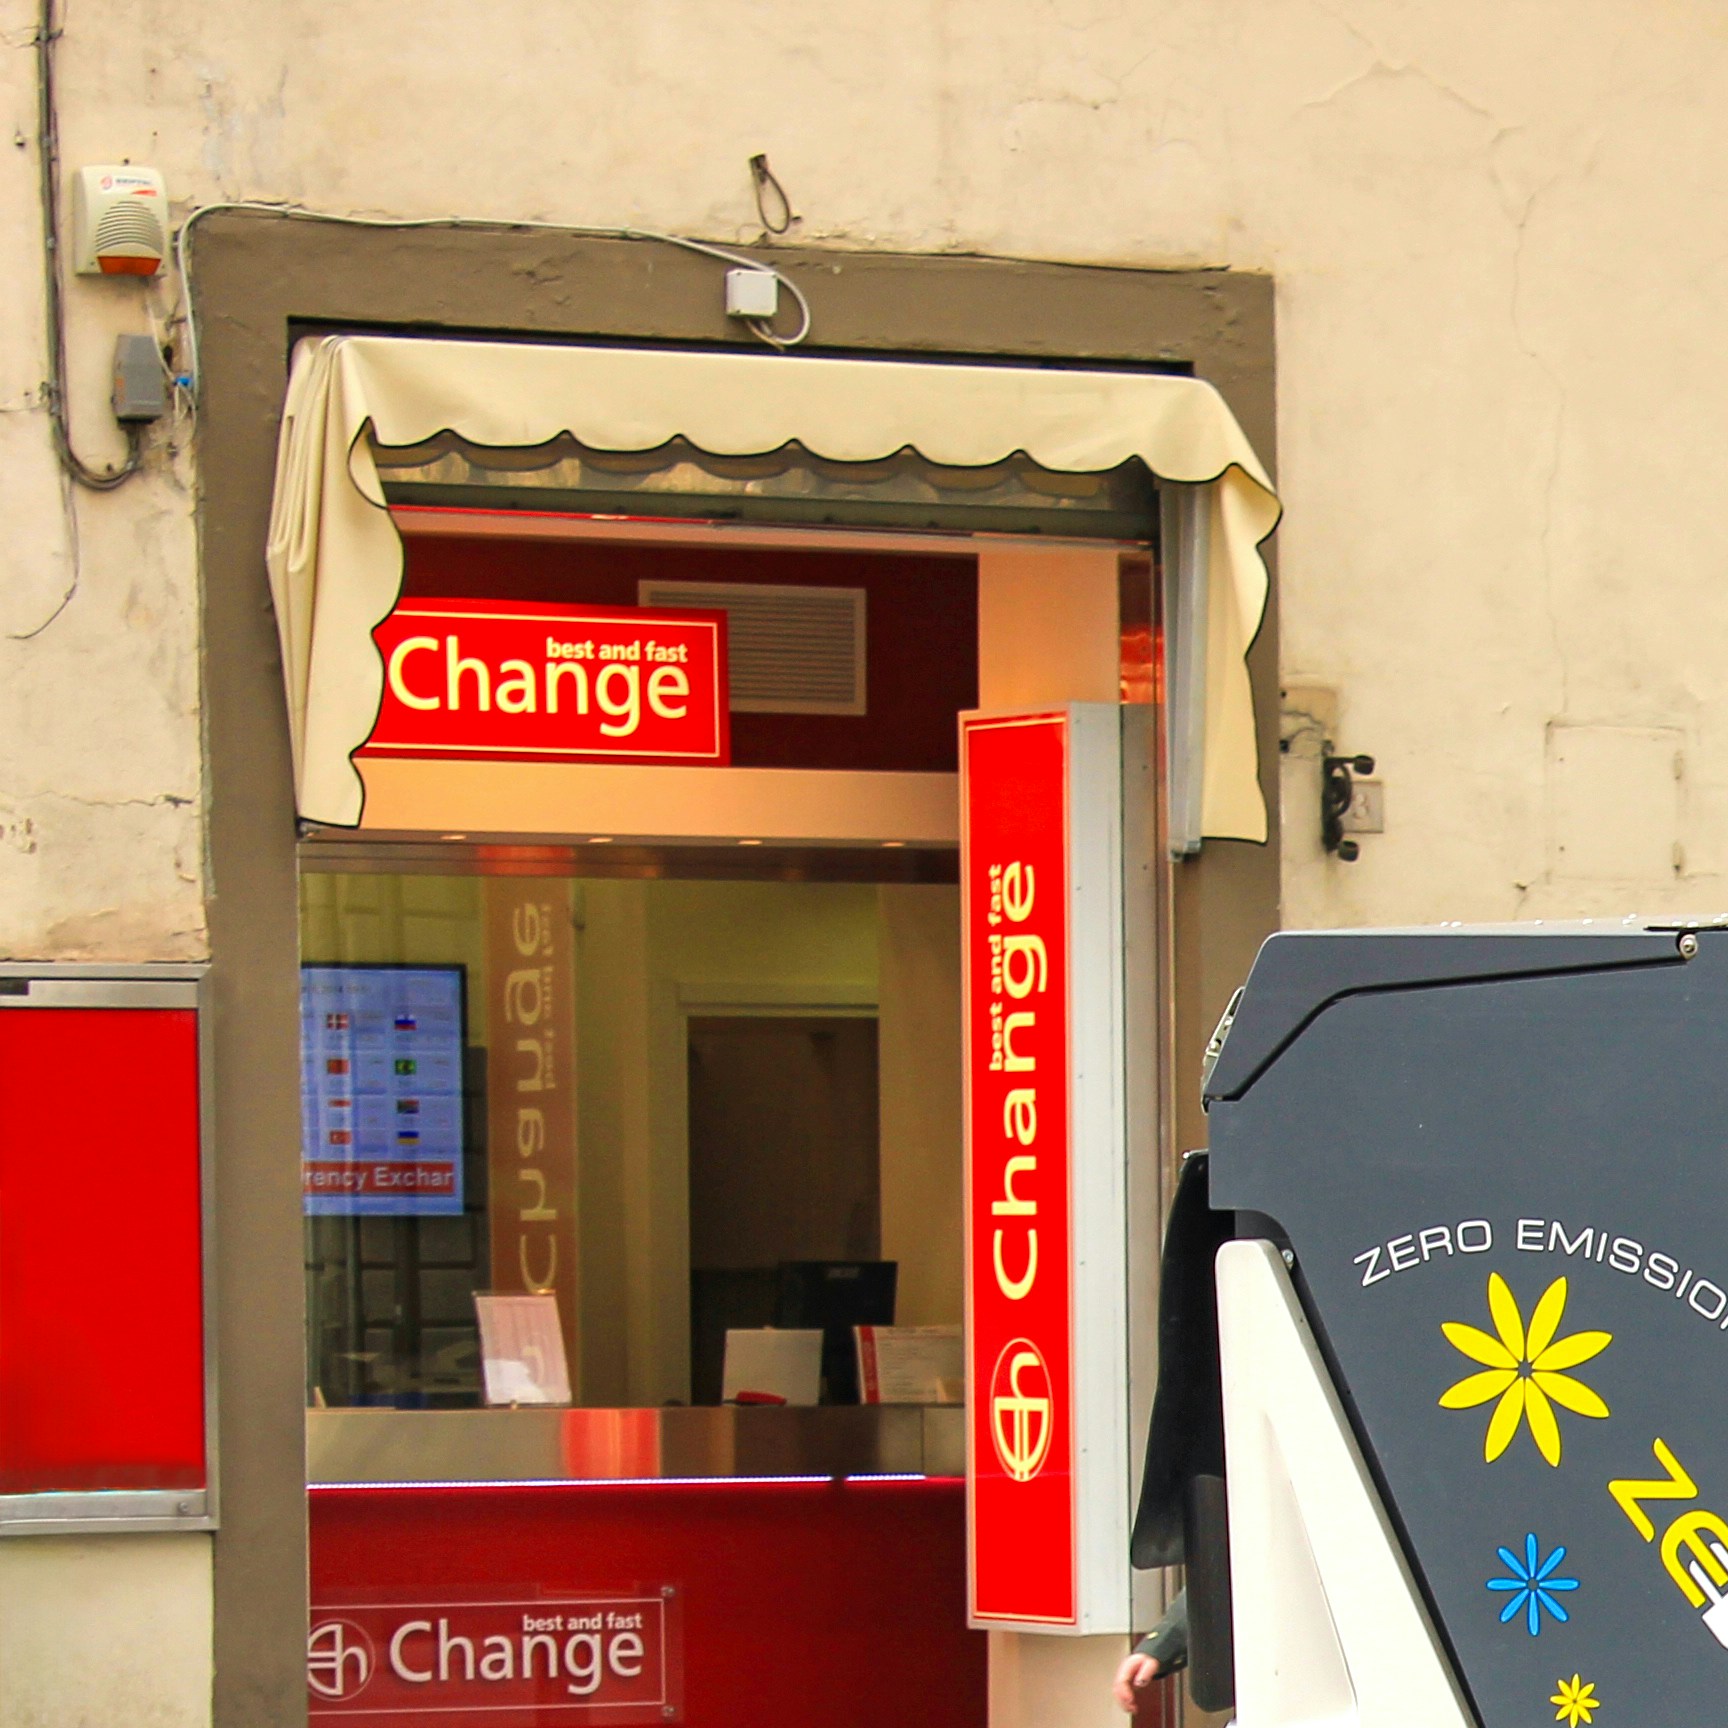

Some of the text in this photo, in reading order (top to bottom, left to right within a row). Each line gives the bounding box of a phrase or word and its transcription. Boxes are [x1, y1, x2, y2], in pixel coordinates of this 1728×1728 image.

[388, 635, 690, 737] Change
[546, 636, 688, 663] best and fast
[987, 863, 1002, 1071] best and fast
[993, 861, 1048, 1301] Change
[1353, 1218, 1495, 1287] ZERO
[390, 1618, 644, 1695] Change
[523, 1612, 643, 1632] best and fast
